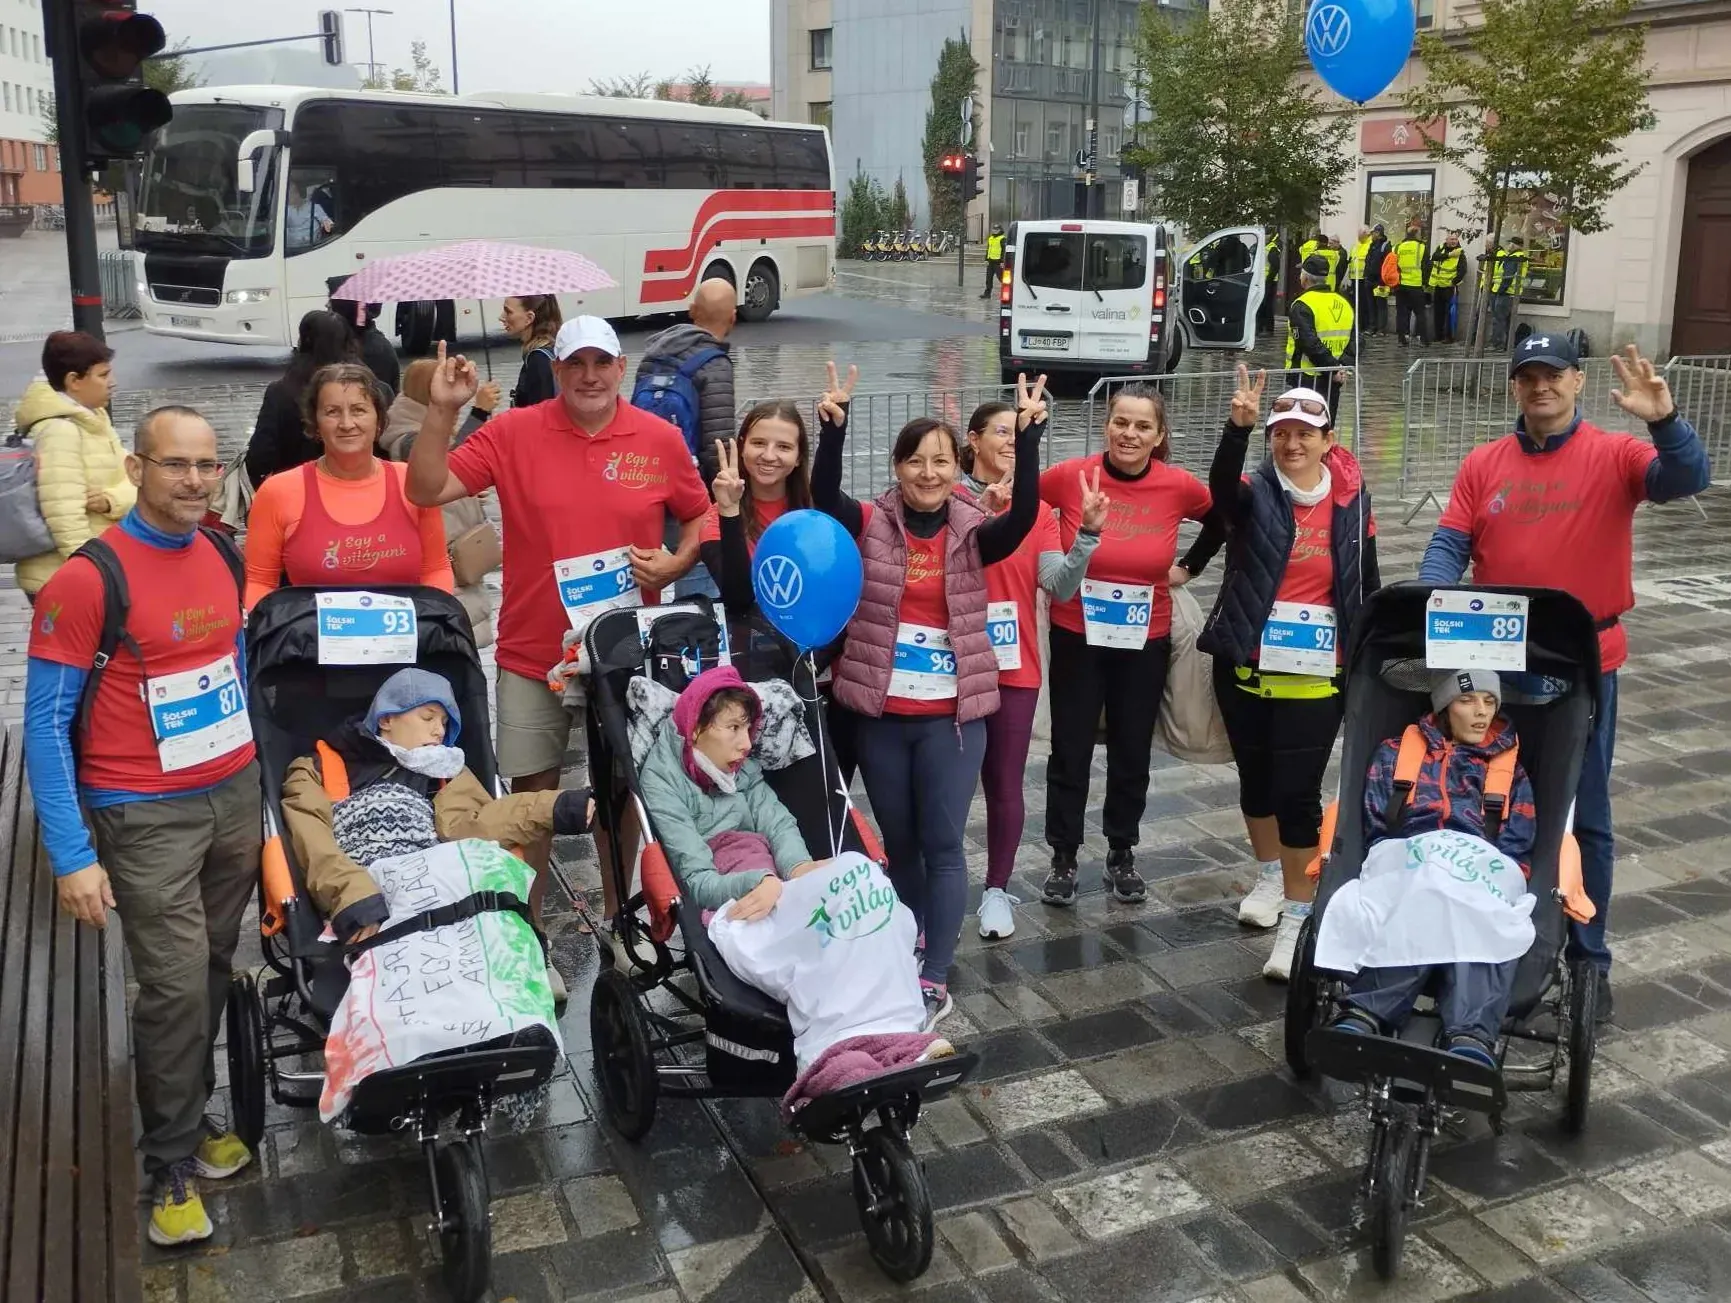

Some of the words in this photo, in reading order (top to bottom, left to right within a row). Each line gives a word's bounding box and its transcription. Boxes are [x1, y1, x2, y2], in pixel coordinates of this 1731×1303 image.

[1091, 308, 1126, 321] valina
[626, 452, 649, 466] Egy
[652, 456, 660, 465] a
[620, 467, 669, 484] világunk
[345, 536, 372, 549] Egy
[377, 533, 386, 542] a
[759, 556, 802, 608] VW
[383, 611, 411, 633] 93
[1126, 604, 1147, 624] 86
[1433, 618, 1463, 628] ŠOLSKI
[993, 622, 1014, 644] 90
[1315, 627, 1333, 649] 92
[1434, 626, 1451, 634] TEK
[1491, 617, 1521, 639] 89
[930, 652, 955, 672] 96
[220, 686, 237, 715] 87
[162, 707, 197, 721] ŠOLSKI
[163, 719, 184, 731] TEK
[838, 882, 894, 931] világ
